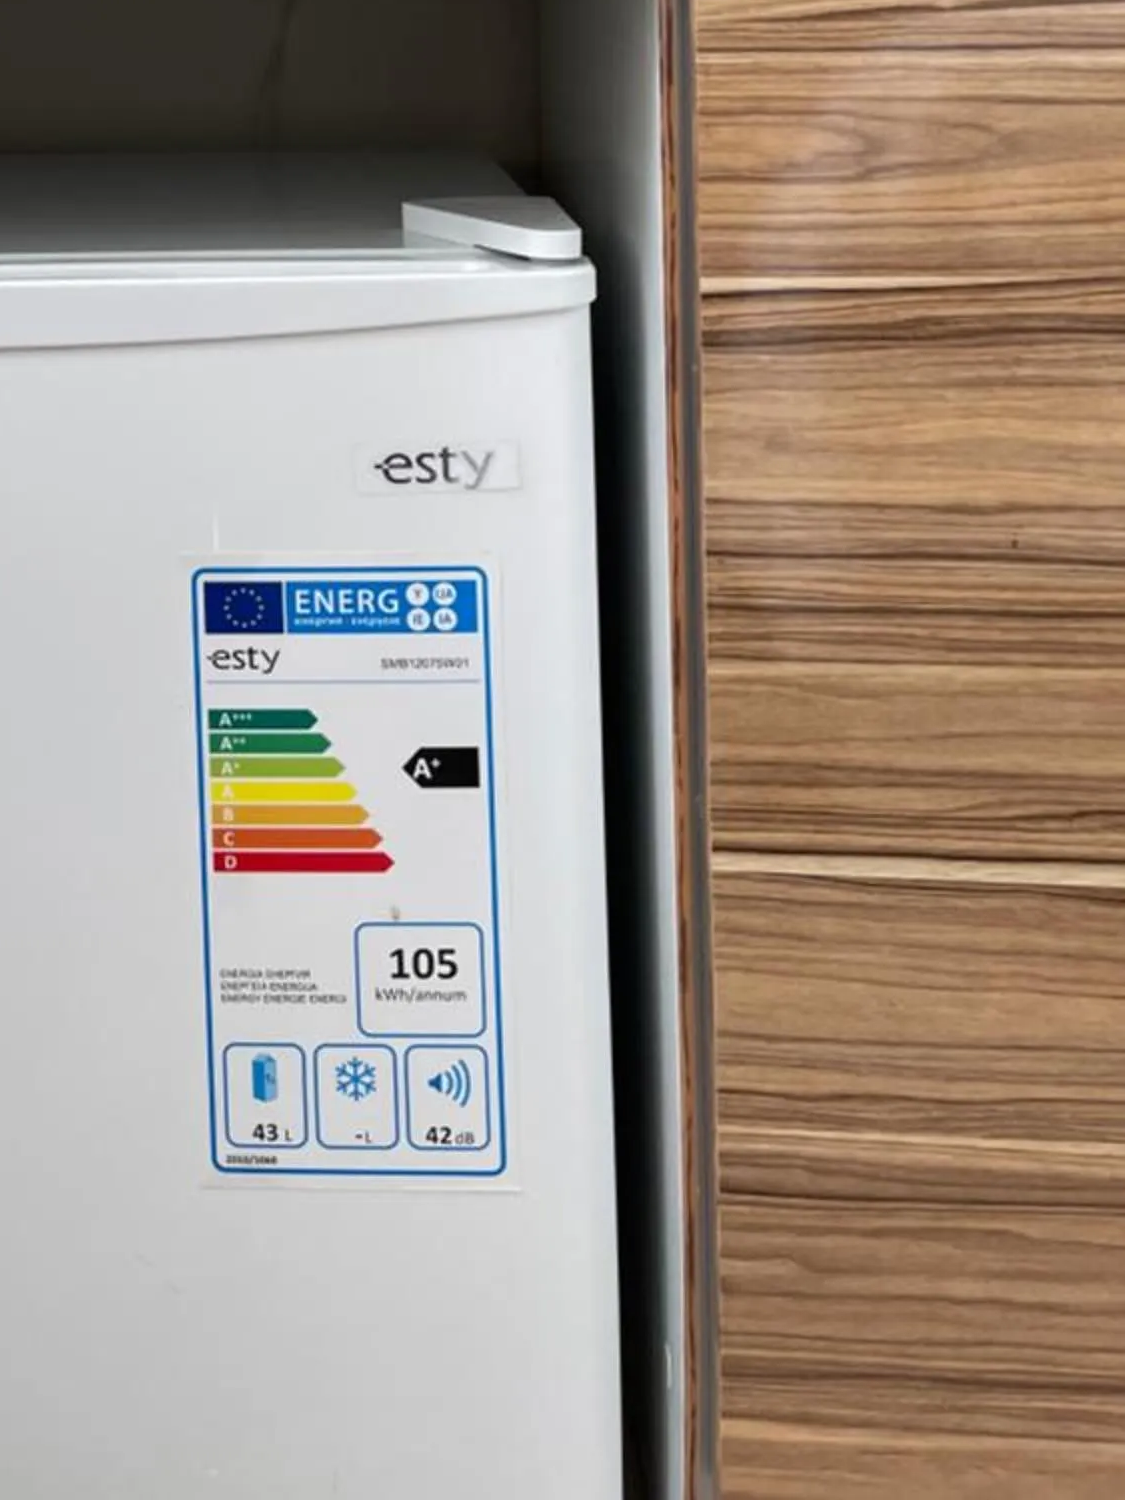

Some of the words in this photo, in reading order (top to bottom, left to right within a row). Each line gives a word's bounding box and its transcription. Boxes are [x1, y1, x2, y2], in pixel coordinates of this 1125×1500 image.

[294, 588, 399, 614] ENERG
[206, 647, 280, 674] esty
[221, 760, 240, 775] A+
[412, 757, 441, 779] A+
[221, 784, 234, 799] A
[223, 808, 234, 822] B
[223, 832, 235, 846] C
[224, 855, 237, 869] D
[389, 948, 459, 980] 105
[375, 987, 467, 1003] kWh/annum
[252, 1123, 279, 1142] 43
[425, 1126, 452, 1145] 42
[455, 1128, 475, 1145] dB
